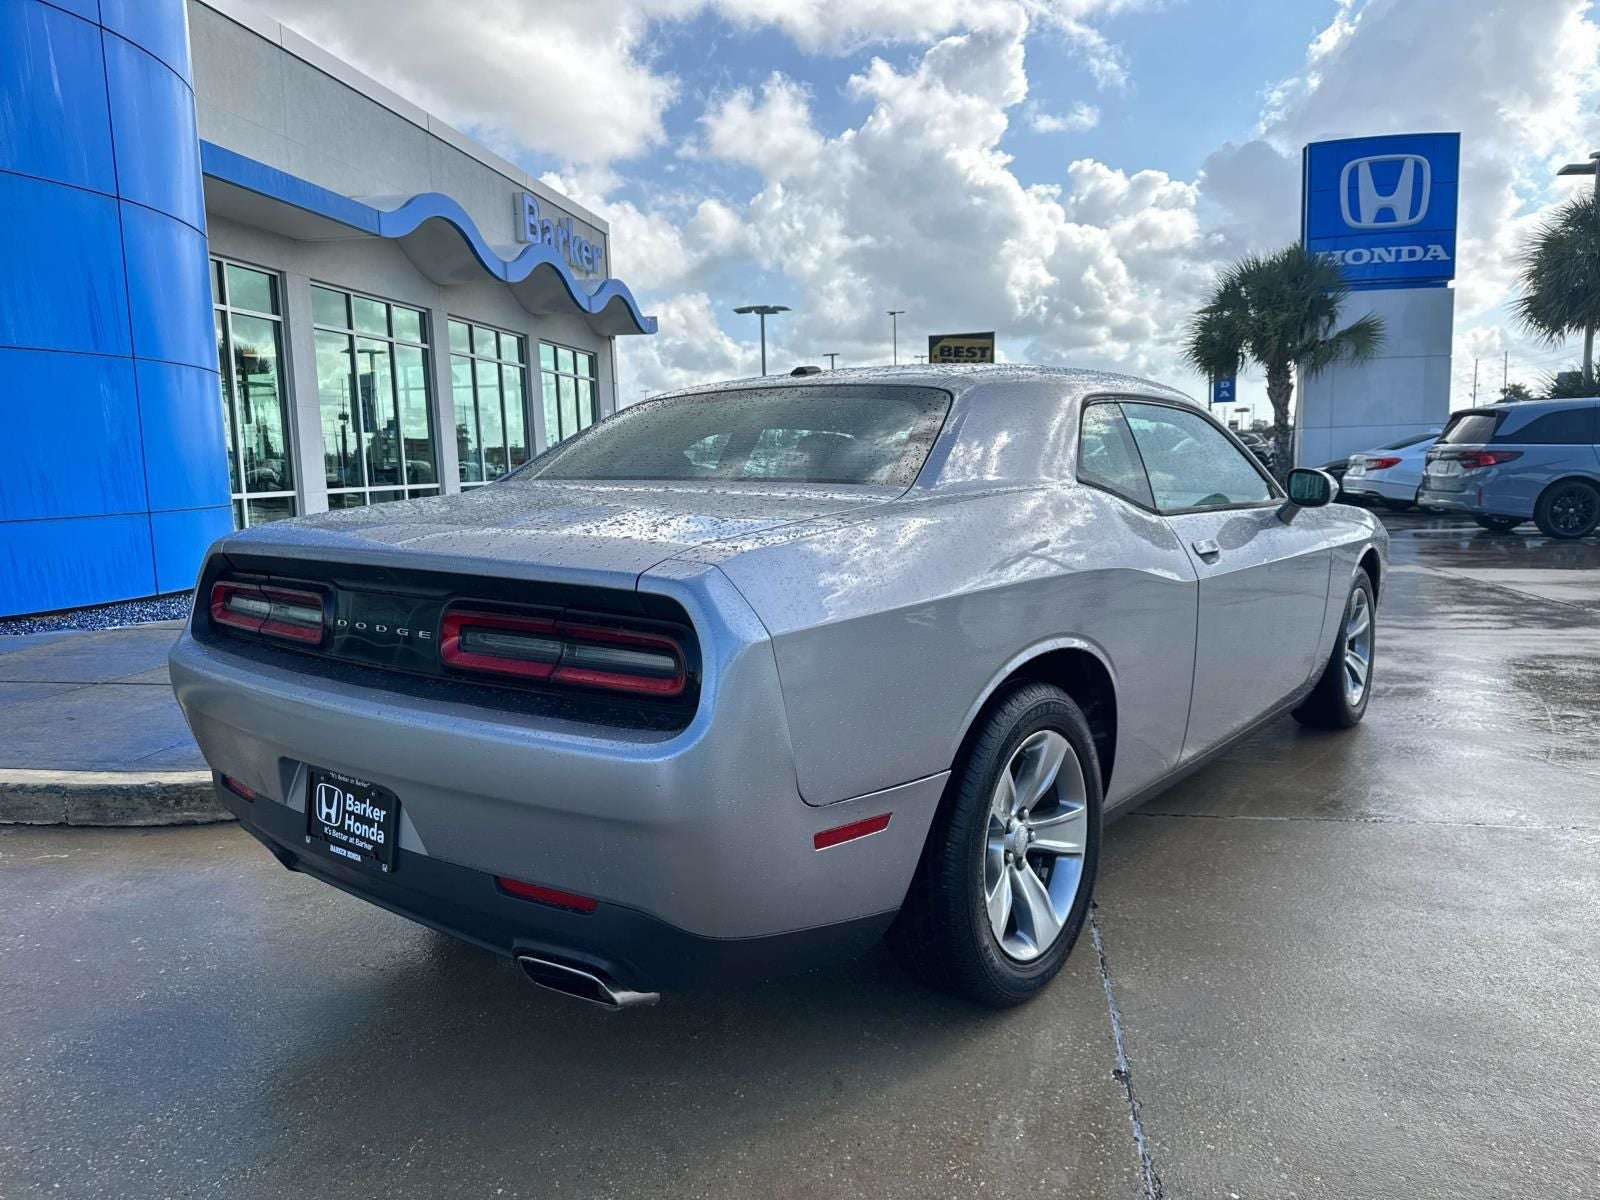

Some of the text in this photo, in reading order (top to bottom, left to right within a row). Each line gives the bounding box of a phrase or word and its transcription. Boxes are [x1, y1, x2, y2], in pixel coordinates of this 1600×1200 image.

[521, 191, 603, 274] Barker
[940, 345, 991, 358] BEST
[337, 619, 432, 639] DODGE
[346, 793, 386, 822] Barker
[324, 826, 332, 835] It's
[332, 829, 348, 841] Better
[355, 838, 373, 850] Barker
[344, 813, 385, 844] Honda
